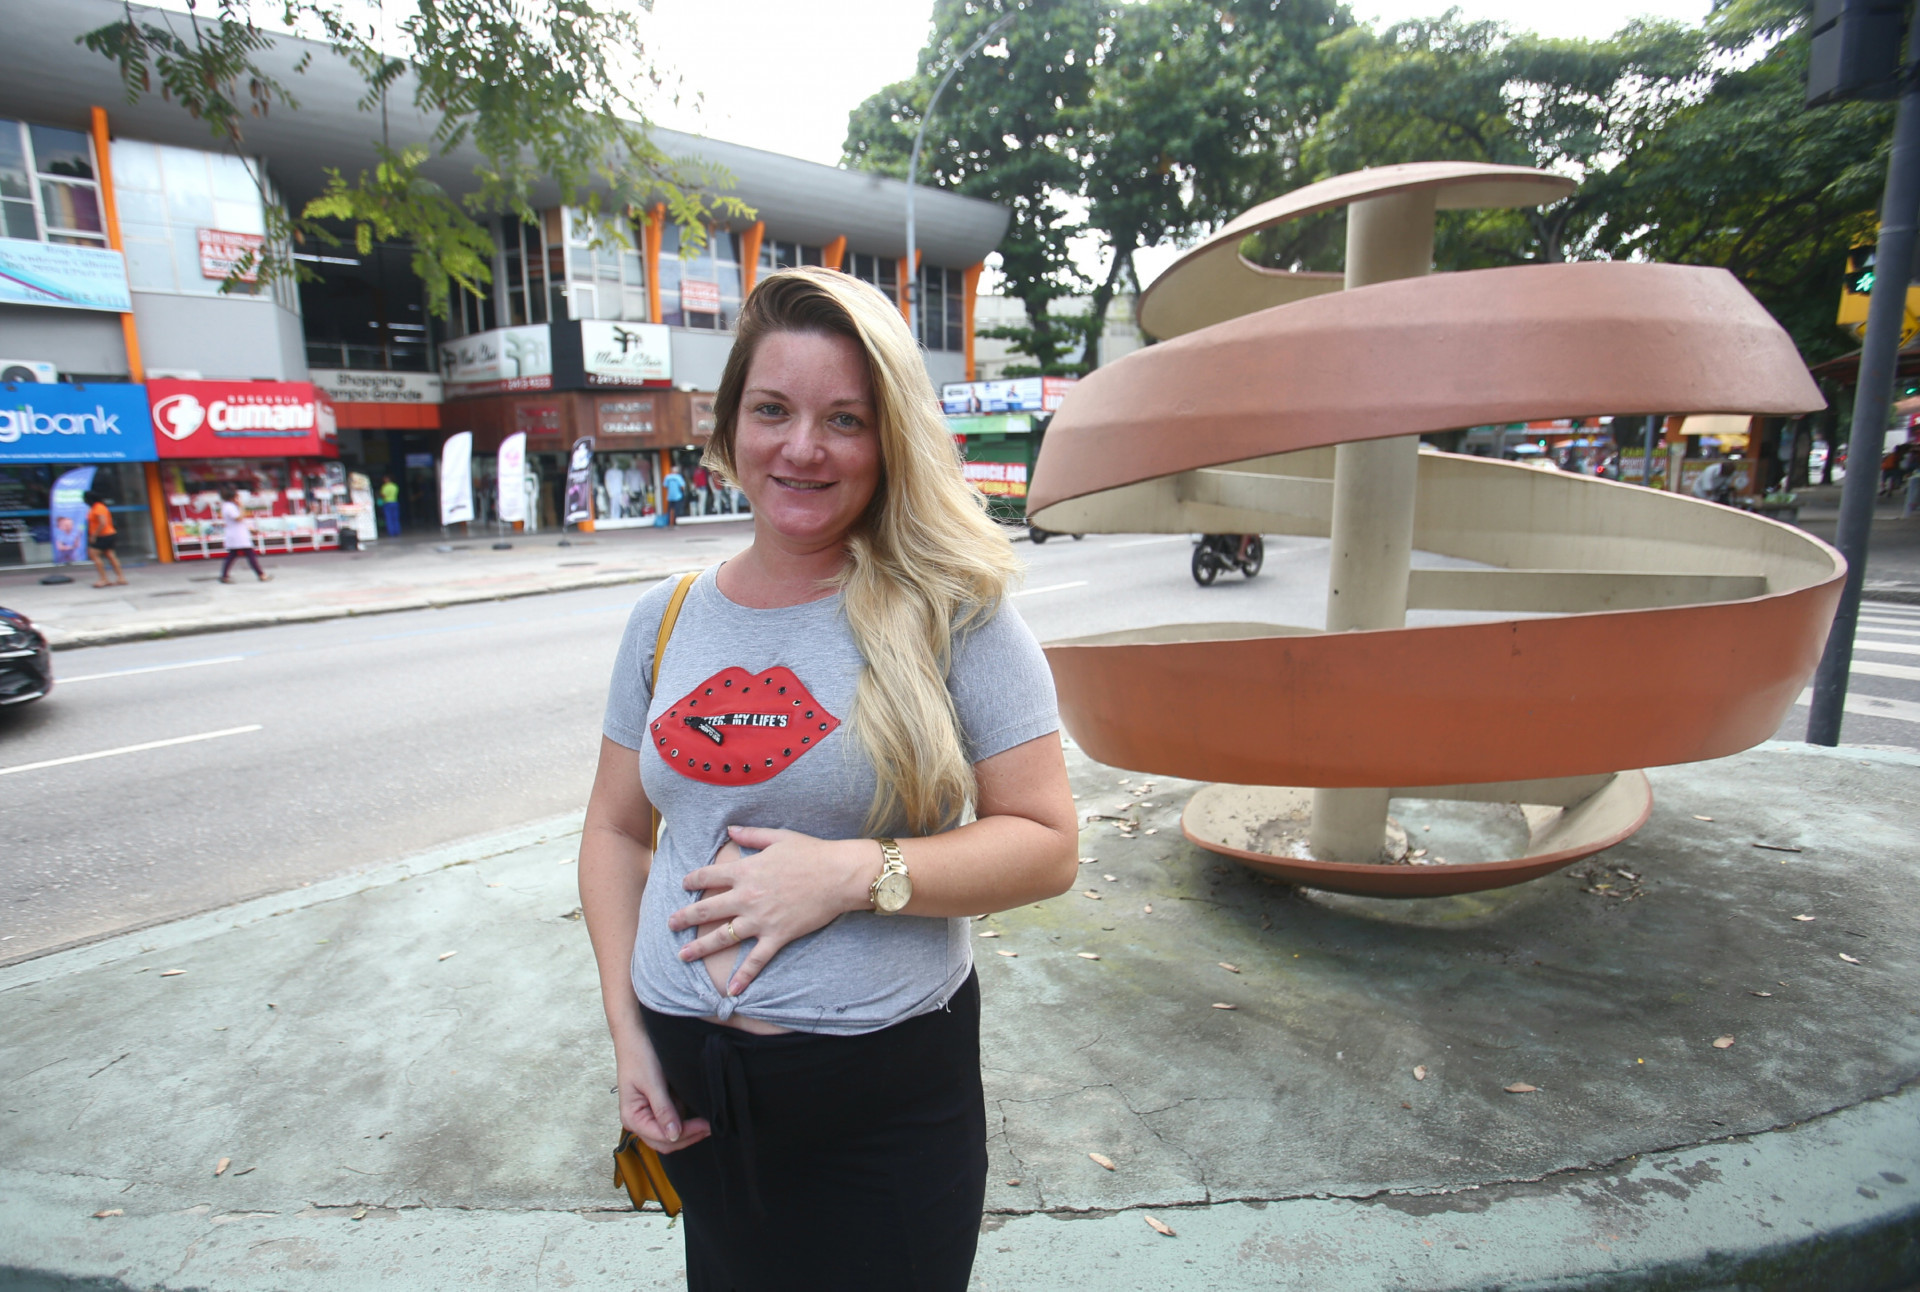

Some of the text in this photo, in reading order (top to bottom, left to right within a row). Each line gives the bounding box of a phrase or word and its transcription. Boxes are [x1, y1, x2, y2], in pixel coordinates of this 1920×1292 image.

[337, 373, 405, 389] Shopping
[328, 388, 423, 401] ampo Grande
[207, 400, 314, 431] Cumani
[732, 713, 751, 726] MY
[752, 714, 788, 727] LIFE'S
